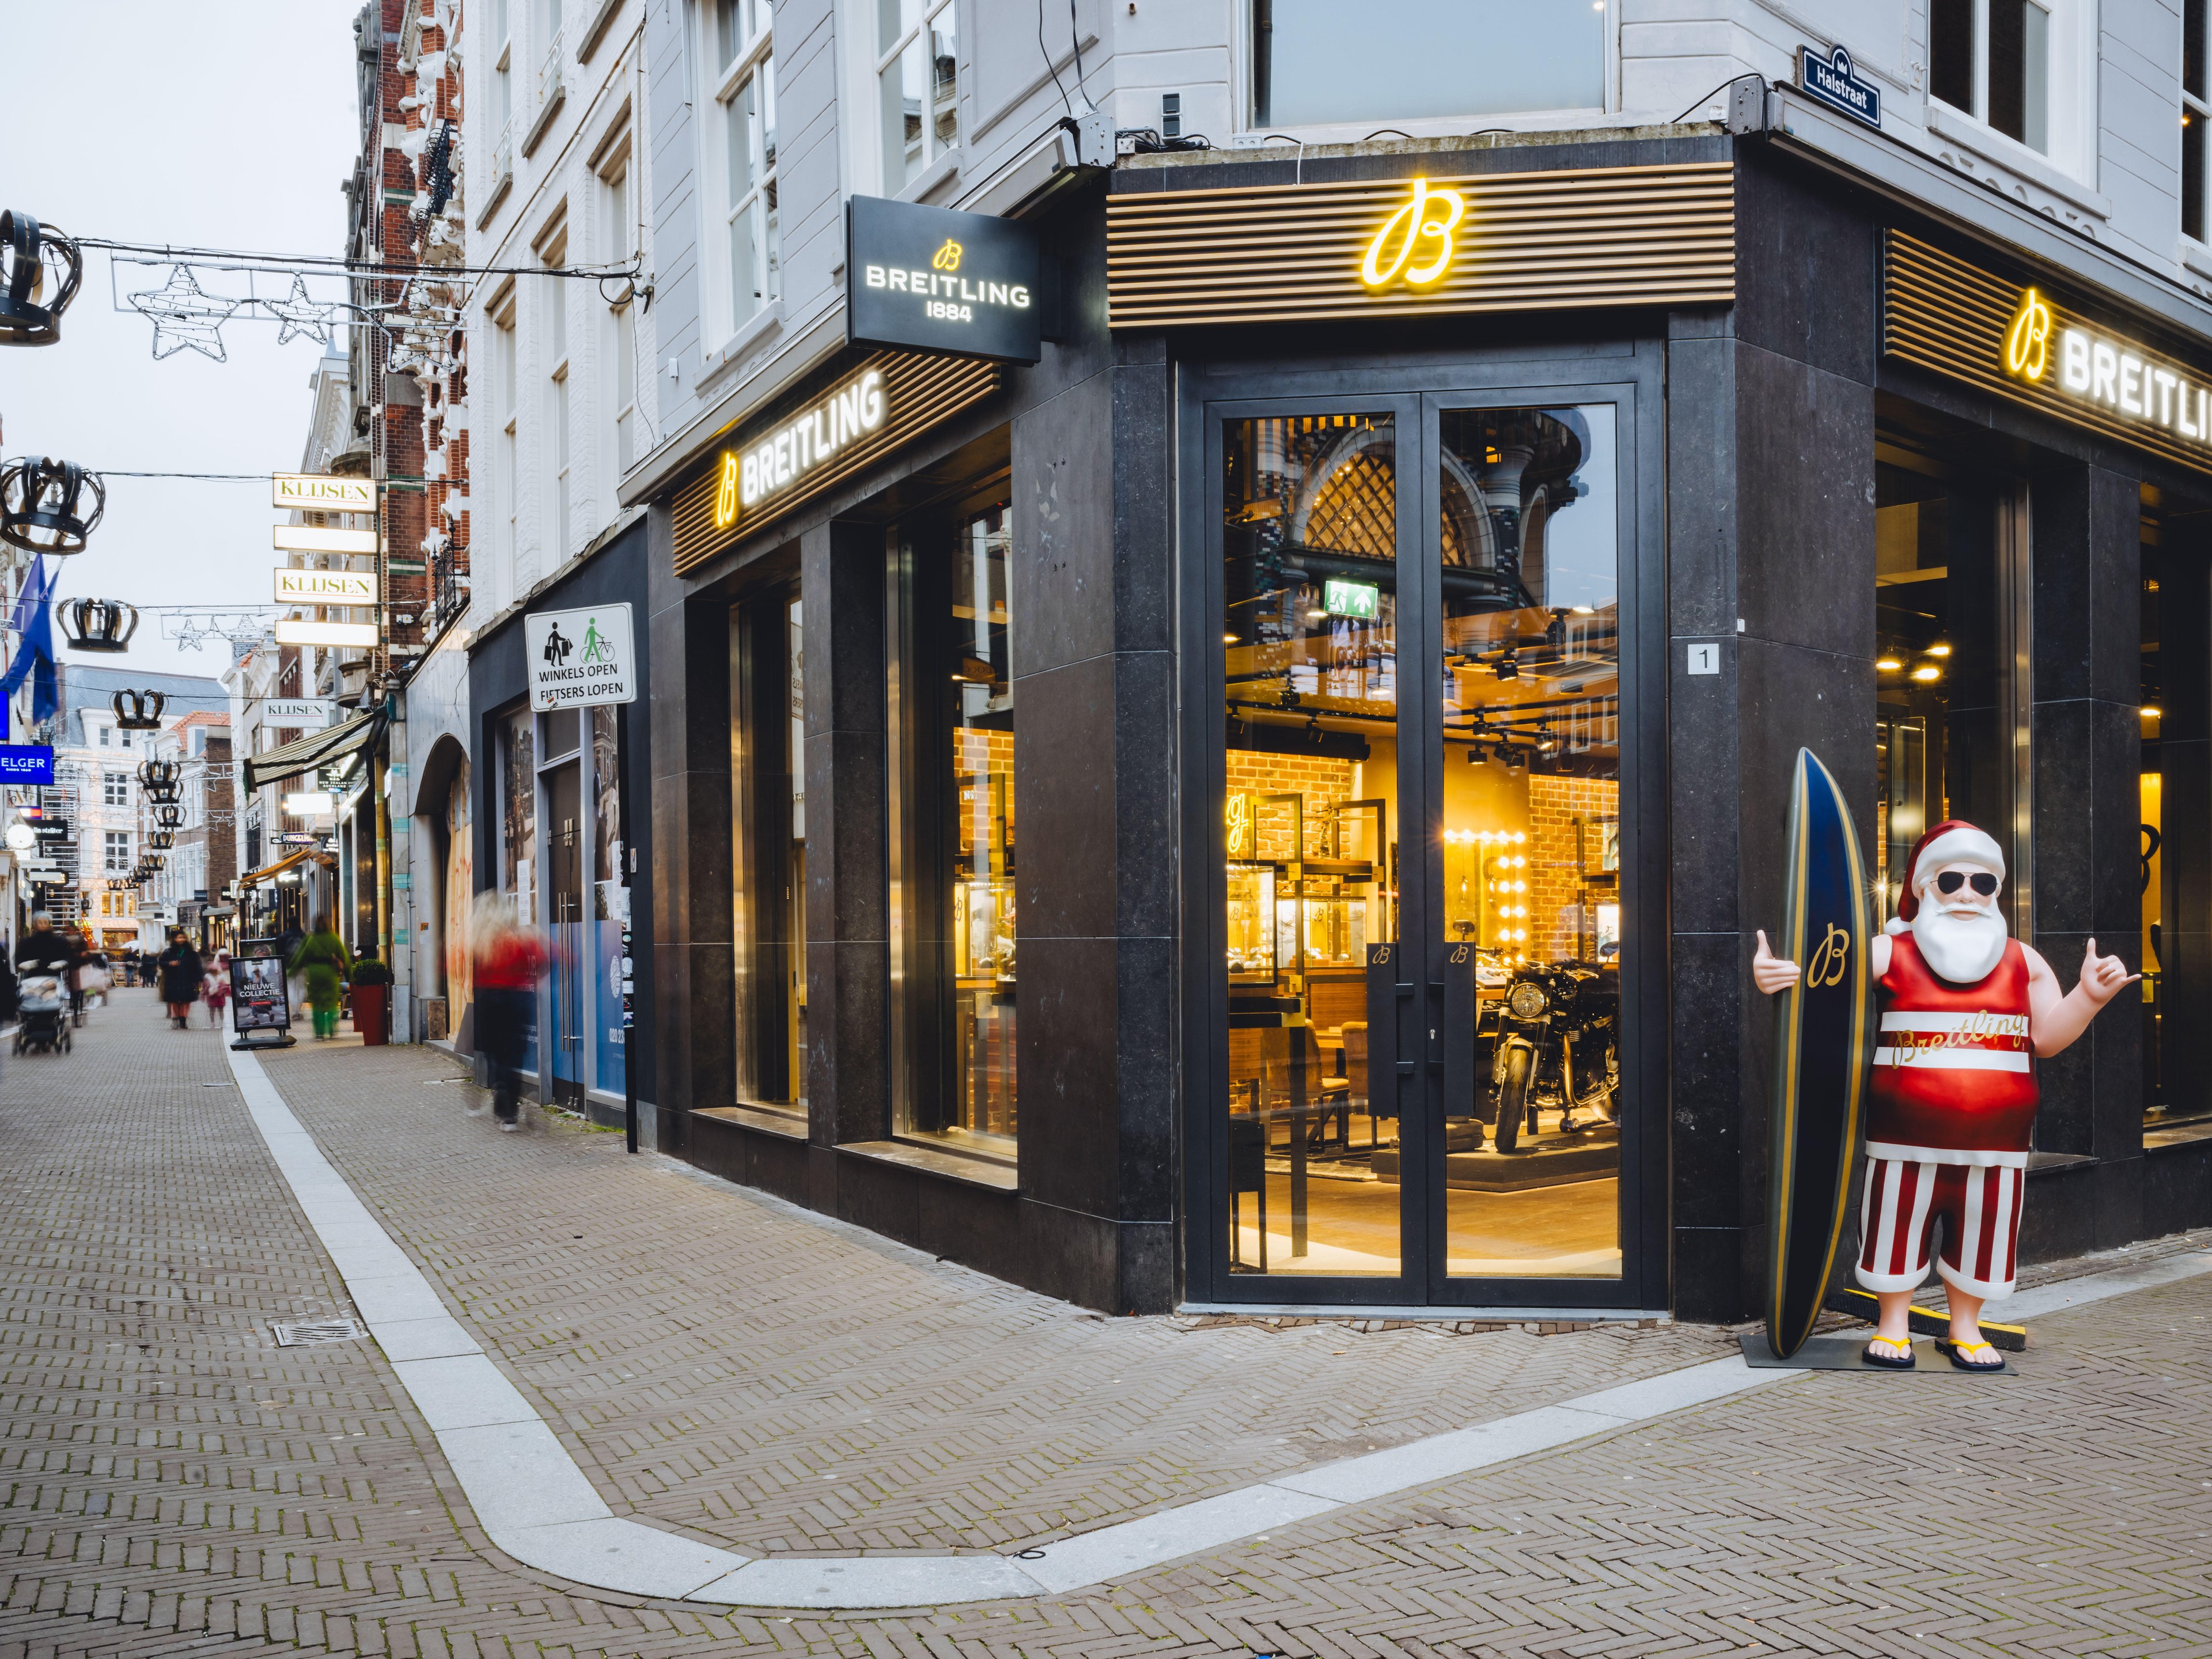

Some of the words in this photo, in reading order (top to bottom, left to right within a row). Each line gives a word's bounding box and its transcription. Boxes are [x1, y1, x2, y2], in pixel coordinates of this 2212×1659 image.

[1817, 65, 1867, 109] Halstraat
[866, 266, 1030, 308] BREITLING
[927, 301, 971, 321] 1884
[2065, 329, 2212, 442] BREITLI
[743, 372, 880, 505] BREITLING
[281, 481, 369, 501] KLIJSEN
[282, 577, 370, 594] KLIJSEN
[1699, 649, 1707, 668] 1
[539, 667, 584, 682] WINKELS
[588, 664, 618, 676] OPEN
[588, 682, 623, 696] LOPEN
[268, 705, 323, 714] KLIJSEN
[1, 757, 45, 768] ELGER
[239, 989, 280, 998] COLLECTIE
[244, 983, 275, 991] NIEUWE
[1892, 1009, 2024, 1070] Breitling
